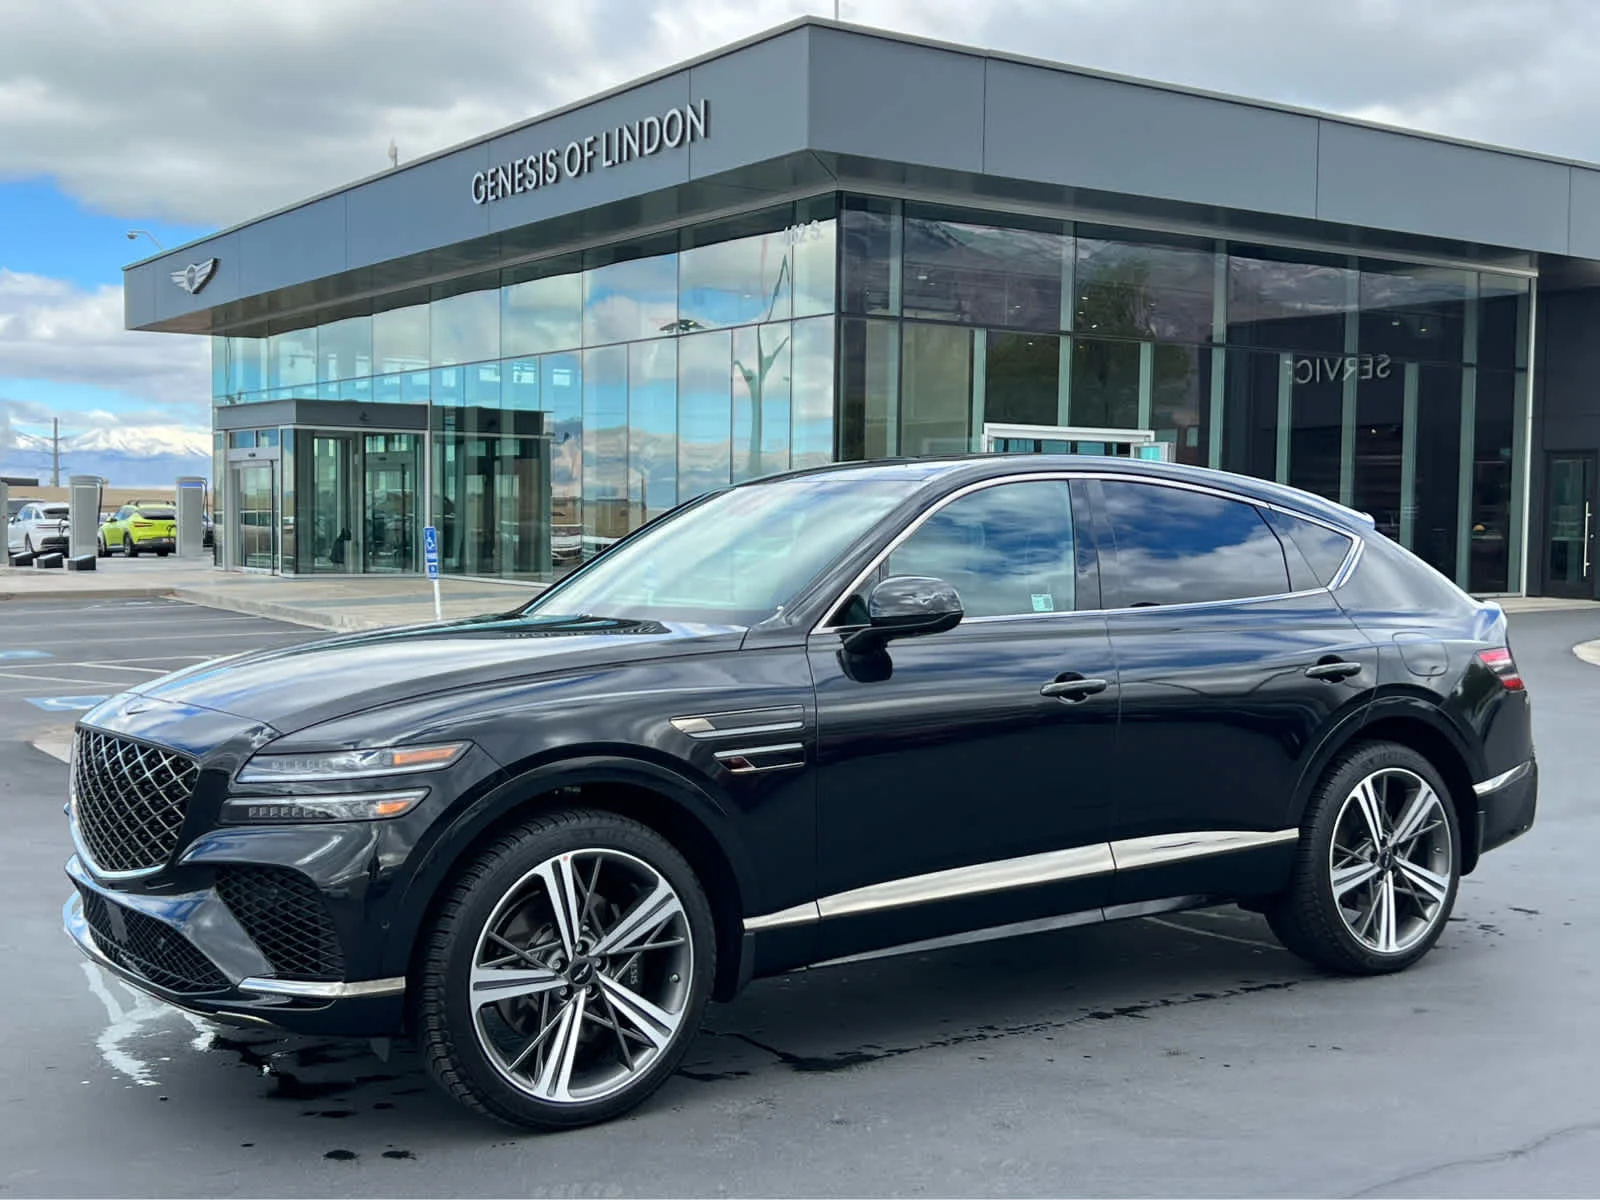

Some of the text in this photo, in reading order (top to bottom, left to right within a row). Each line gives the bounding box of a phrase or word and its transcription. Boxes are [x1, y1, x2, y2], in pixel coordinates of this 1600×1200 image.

[471, 99, 708, 204] GENESIS OF LINDON
